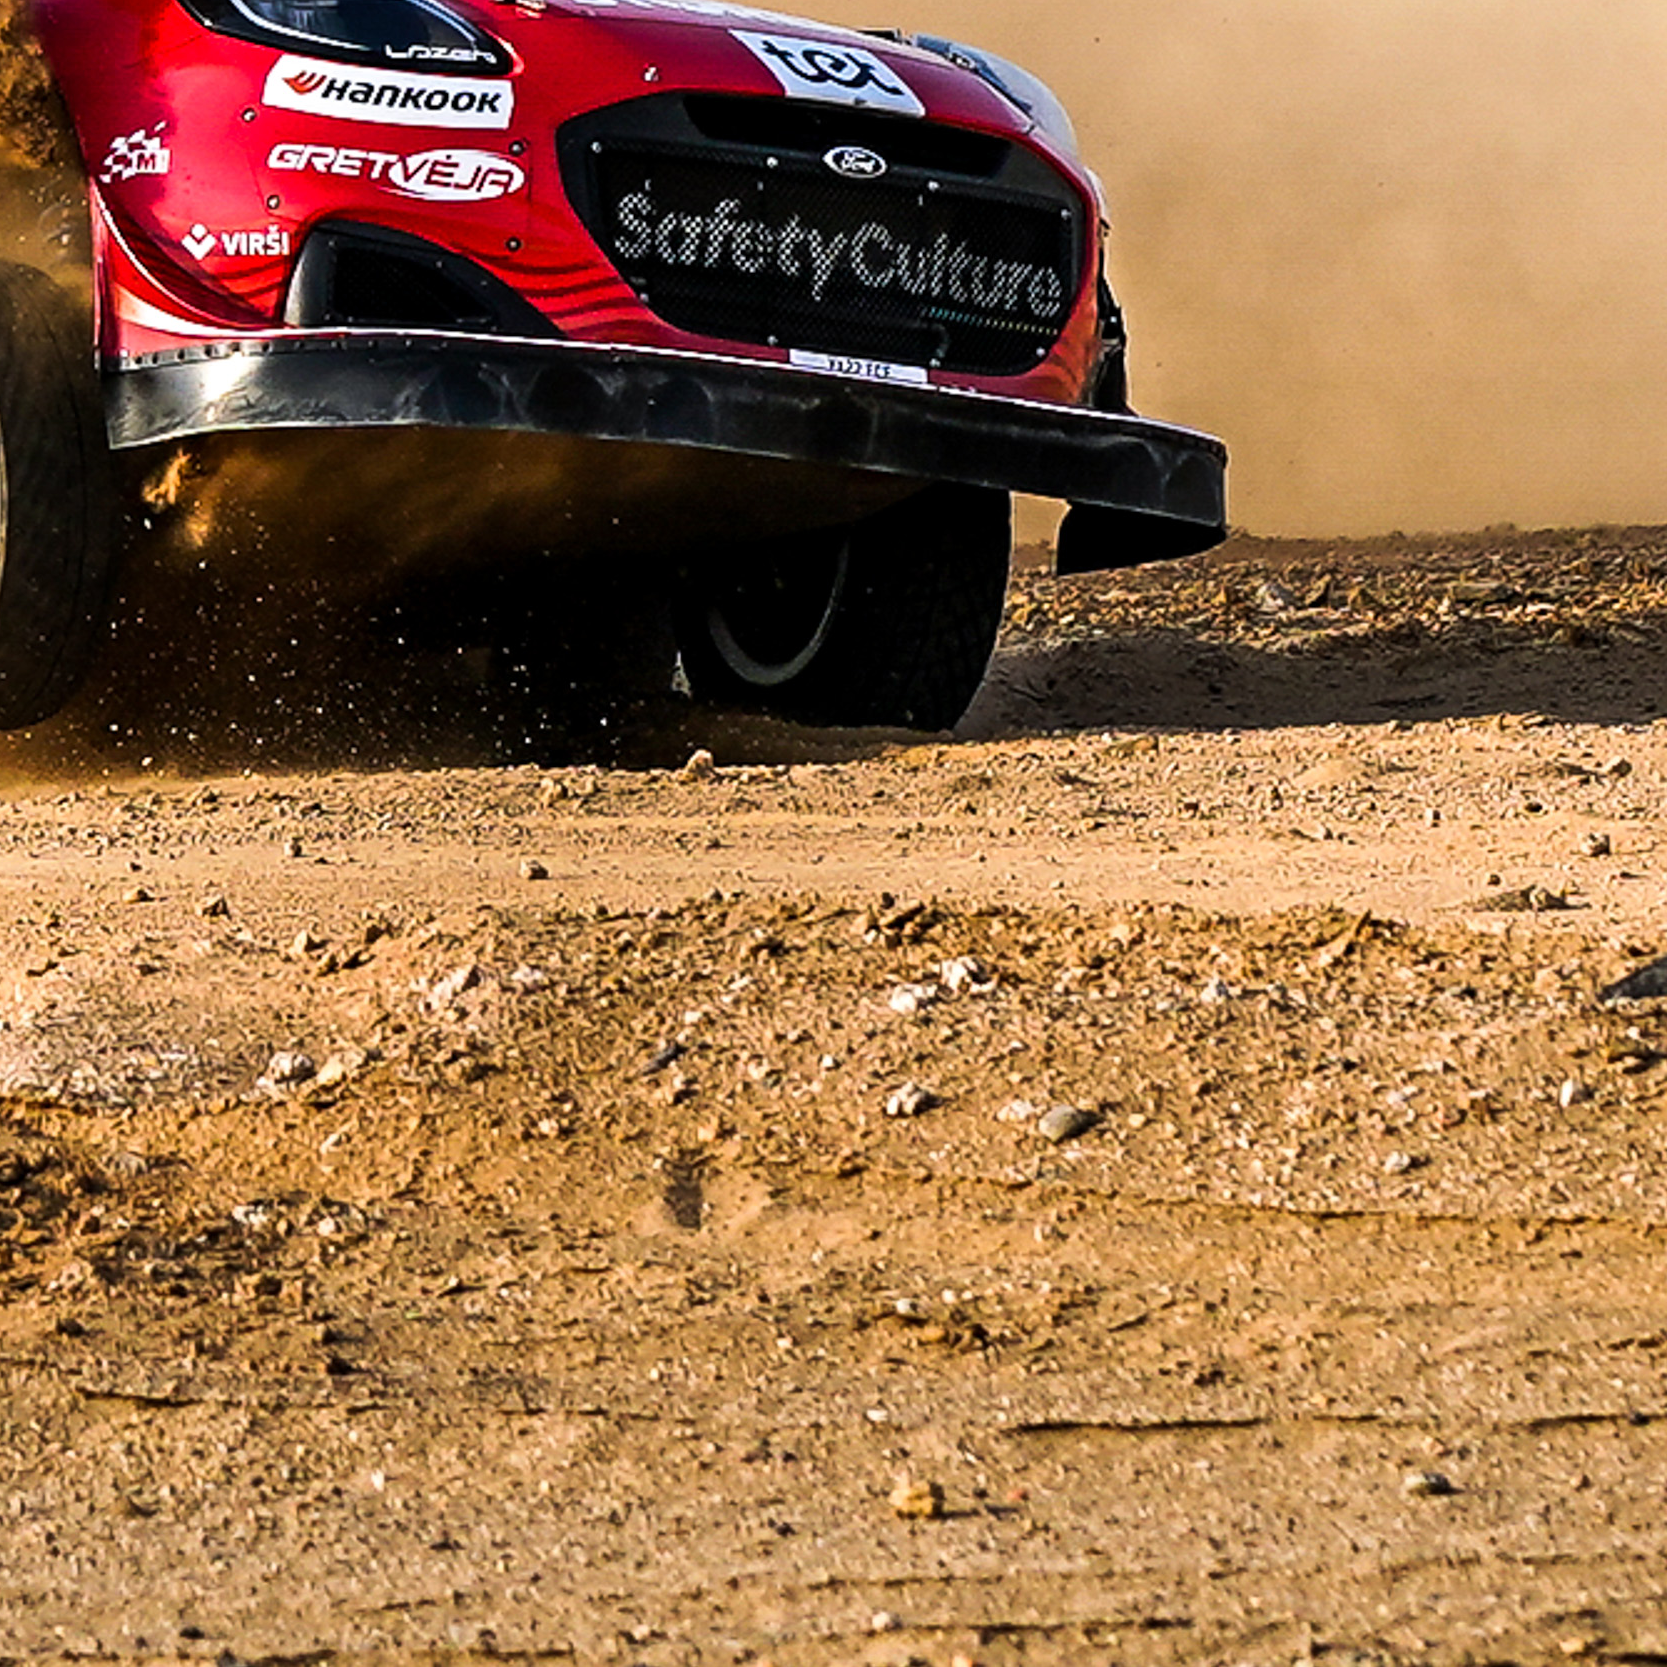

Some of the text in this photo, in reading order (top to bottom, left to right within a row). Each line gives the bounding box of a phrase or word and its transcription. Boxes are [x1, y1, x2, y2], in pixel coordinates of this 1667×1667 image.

[762, 40, 905, 96] tet
[220, 225, 290, 256] VIRŠI
[615, 191, 1063, 317] SafetyCulture
